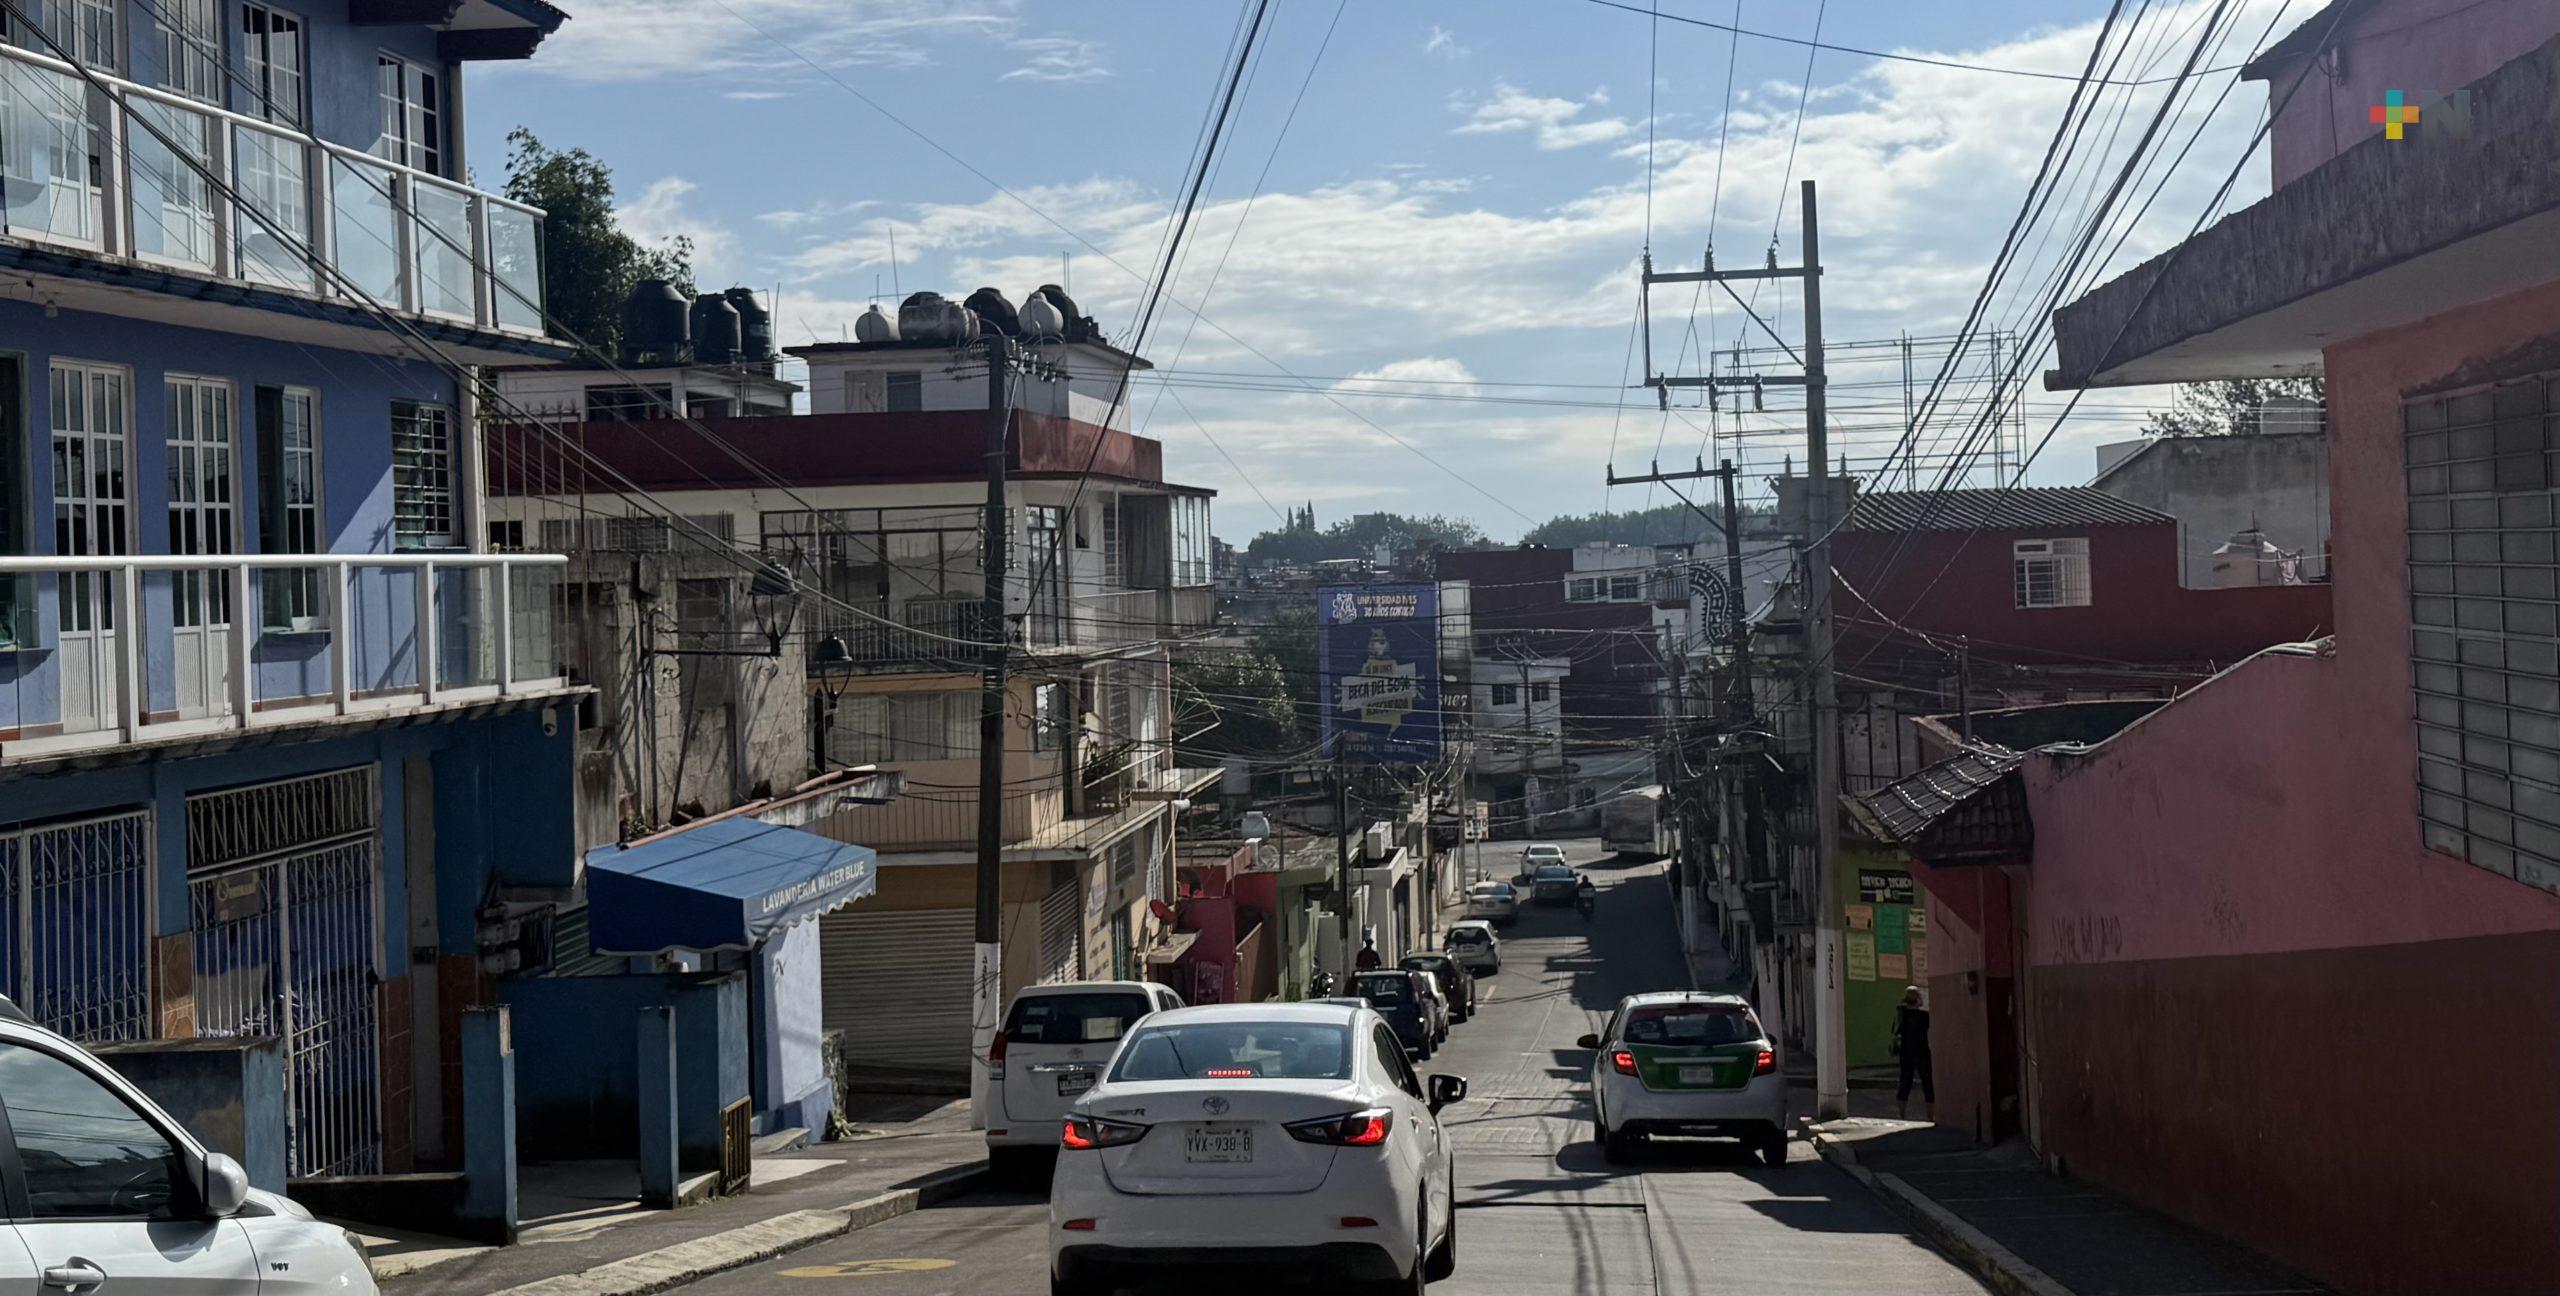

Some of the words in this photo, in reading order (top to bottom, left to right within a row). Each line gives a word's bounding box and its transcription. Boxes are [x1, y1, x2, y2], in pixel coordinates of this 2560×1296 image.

[1357, 594, 1402, 606] UNIVERSIDAD
[1348, 681, 1370, 701] BECA
[1371, 679, 1386, 697] DEL
[818, 869, 844, 889] WATER
[845, 861, 865, 879] BLUE
[1187, 1136, 1250, 1153] YVX-938-B
